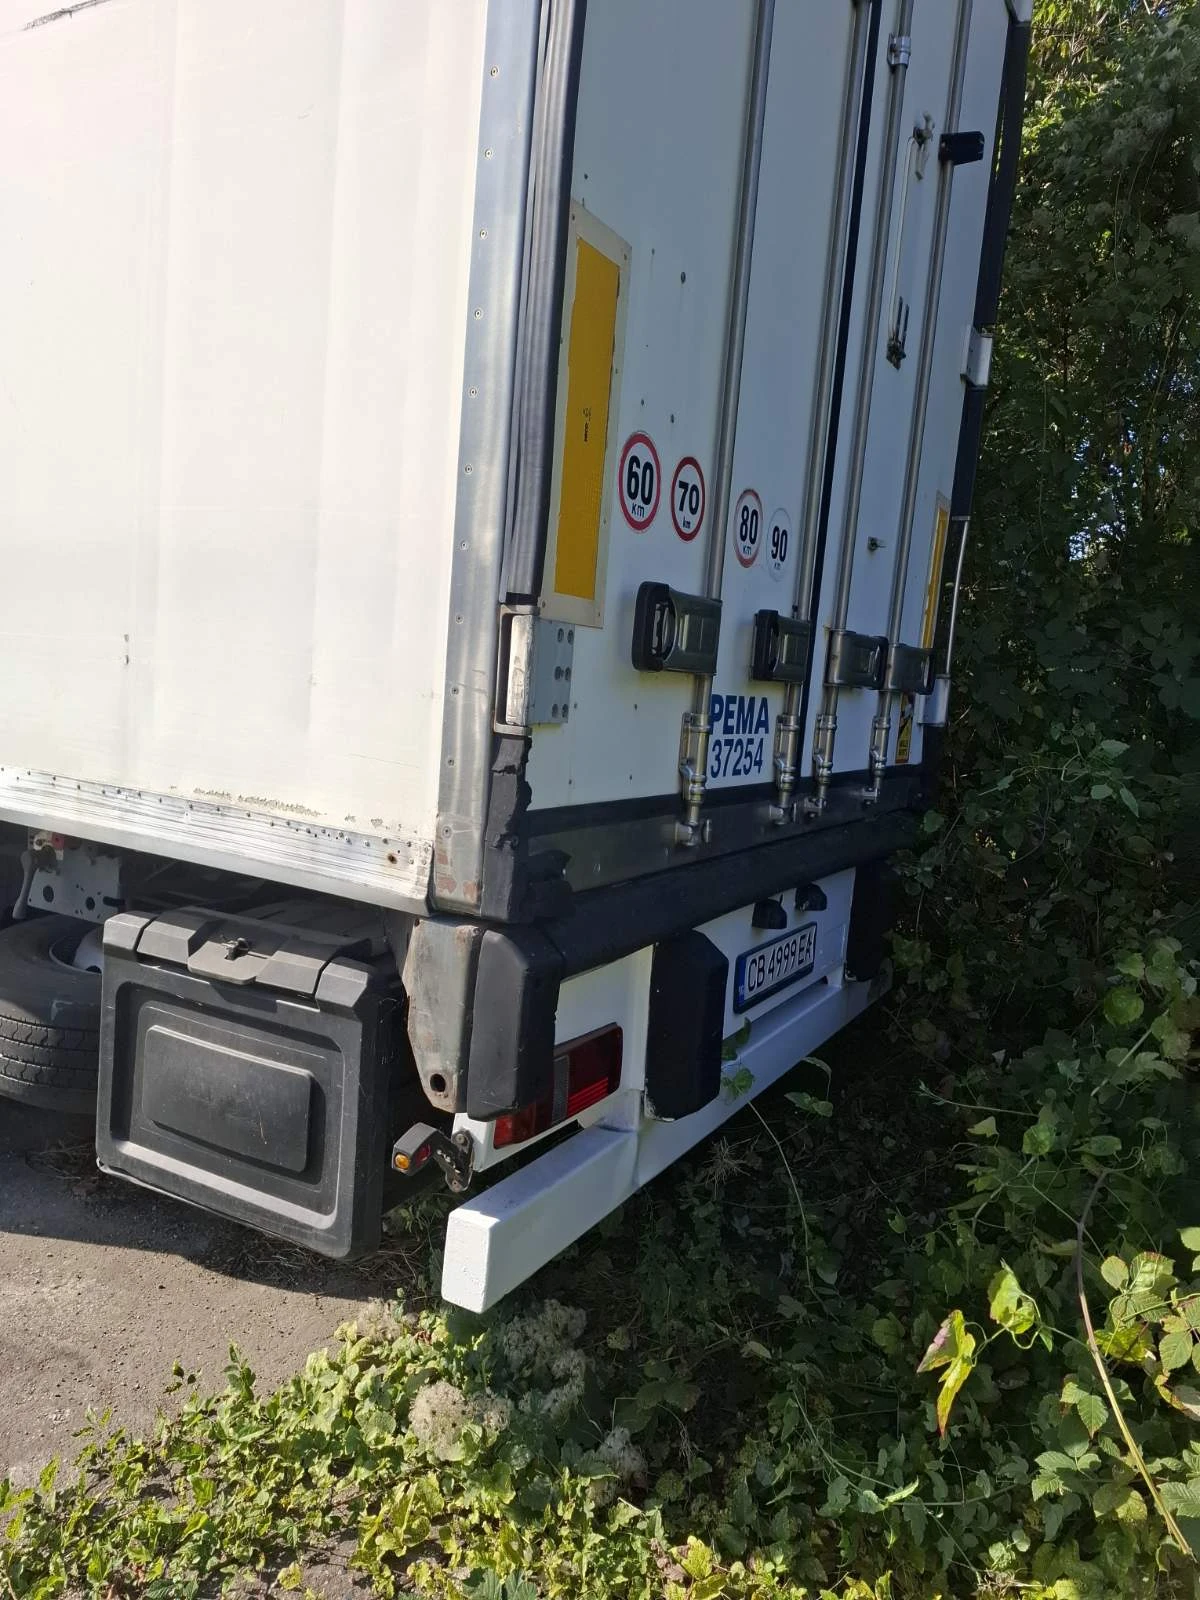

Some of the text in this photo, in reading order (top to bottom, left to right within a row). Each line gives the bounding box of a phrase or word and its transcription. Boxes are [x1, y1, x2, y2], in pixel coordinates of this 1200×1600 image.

[627, 455, 654, 505] 60
[678, 480, 700, 515] 70
[739, 505, 758, 545] 80
[771, 525, 788, 562] 90
[710, 693, 769, 735] PEMA
[710, 738, 763, 778] 37254
[747, 954, 765, 992] CB
[767, 939, 797, 981] 4999
